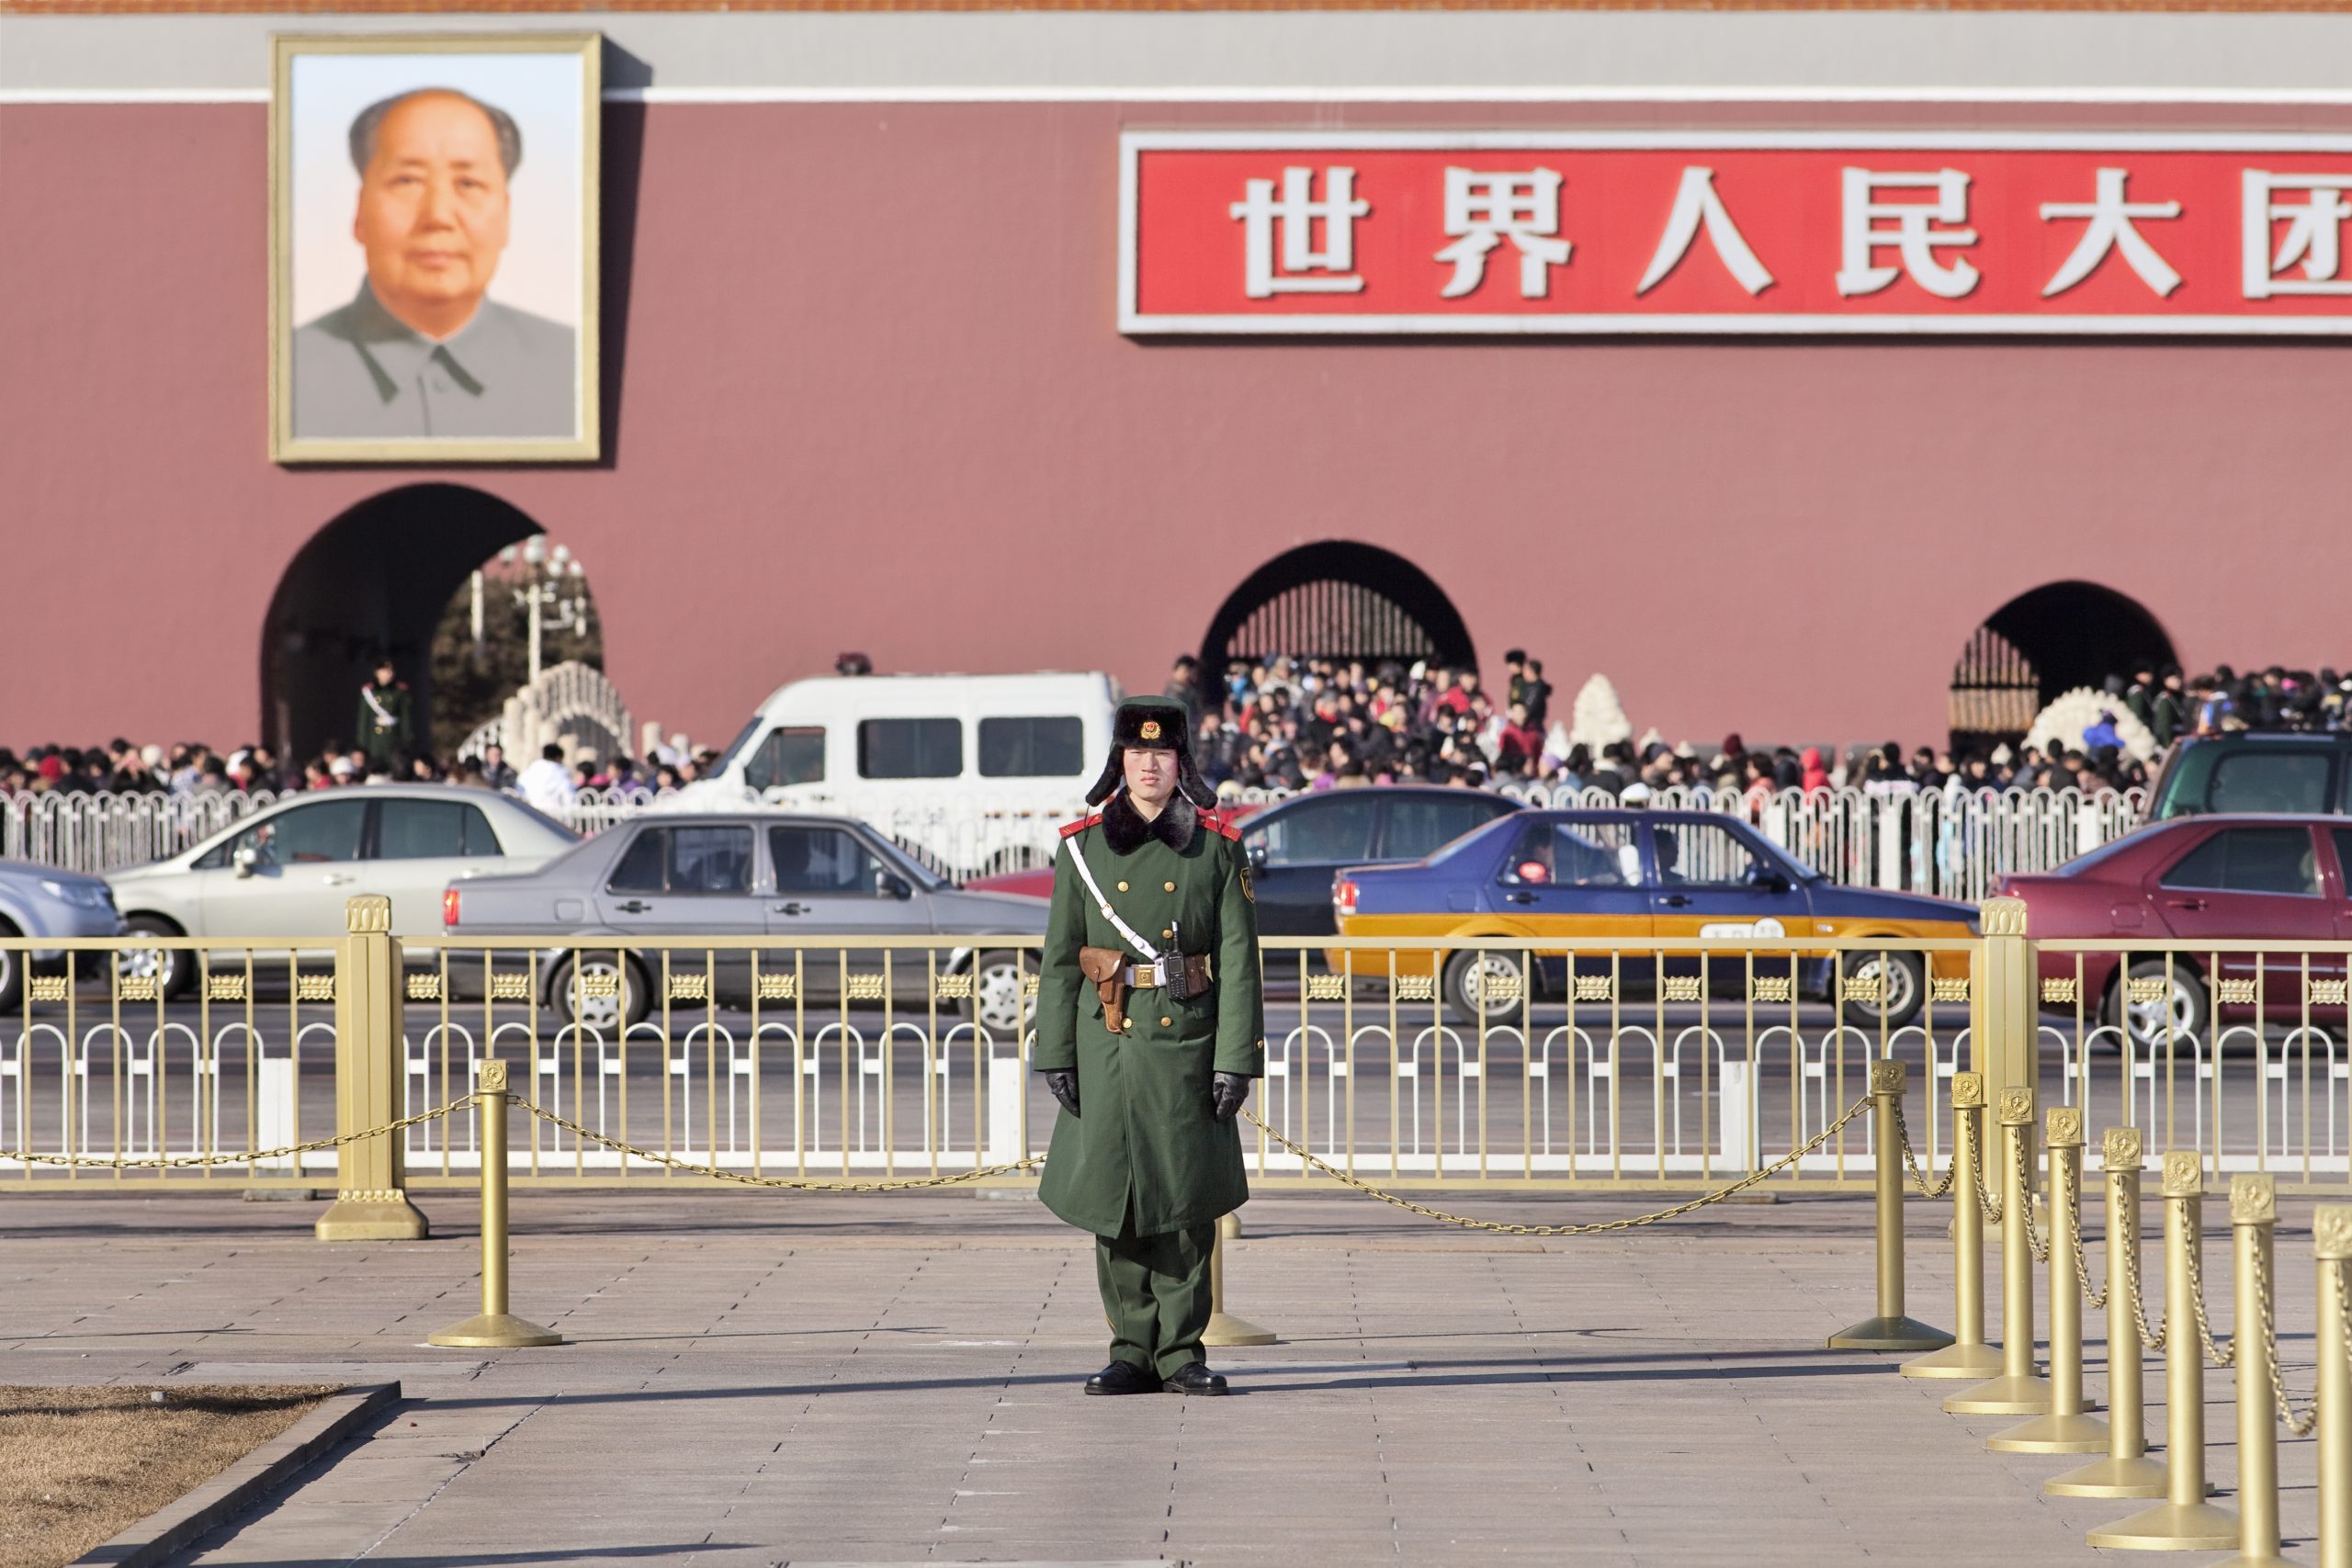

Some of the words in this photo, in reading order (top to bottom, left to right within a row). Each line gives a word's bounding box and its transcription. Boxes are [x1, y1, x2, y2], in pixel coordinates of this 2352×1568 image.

[1229, 166, 2352, 299] 世界人民大团
